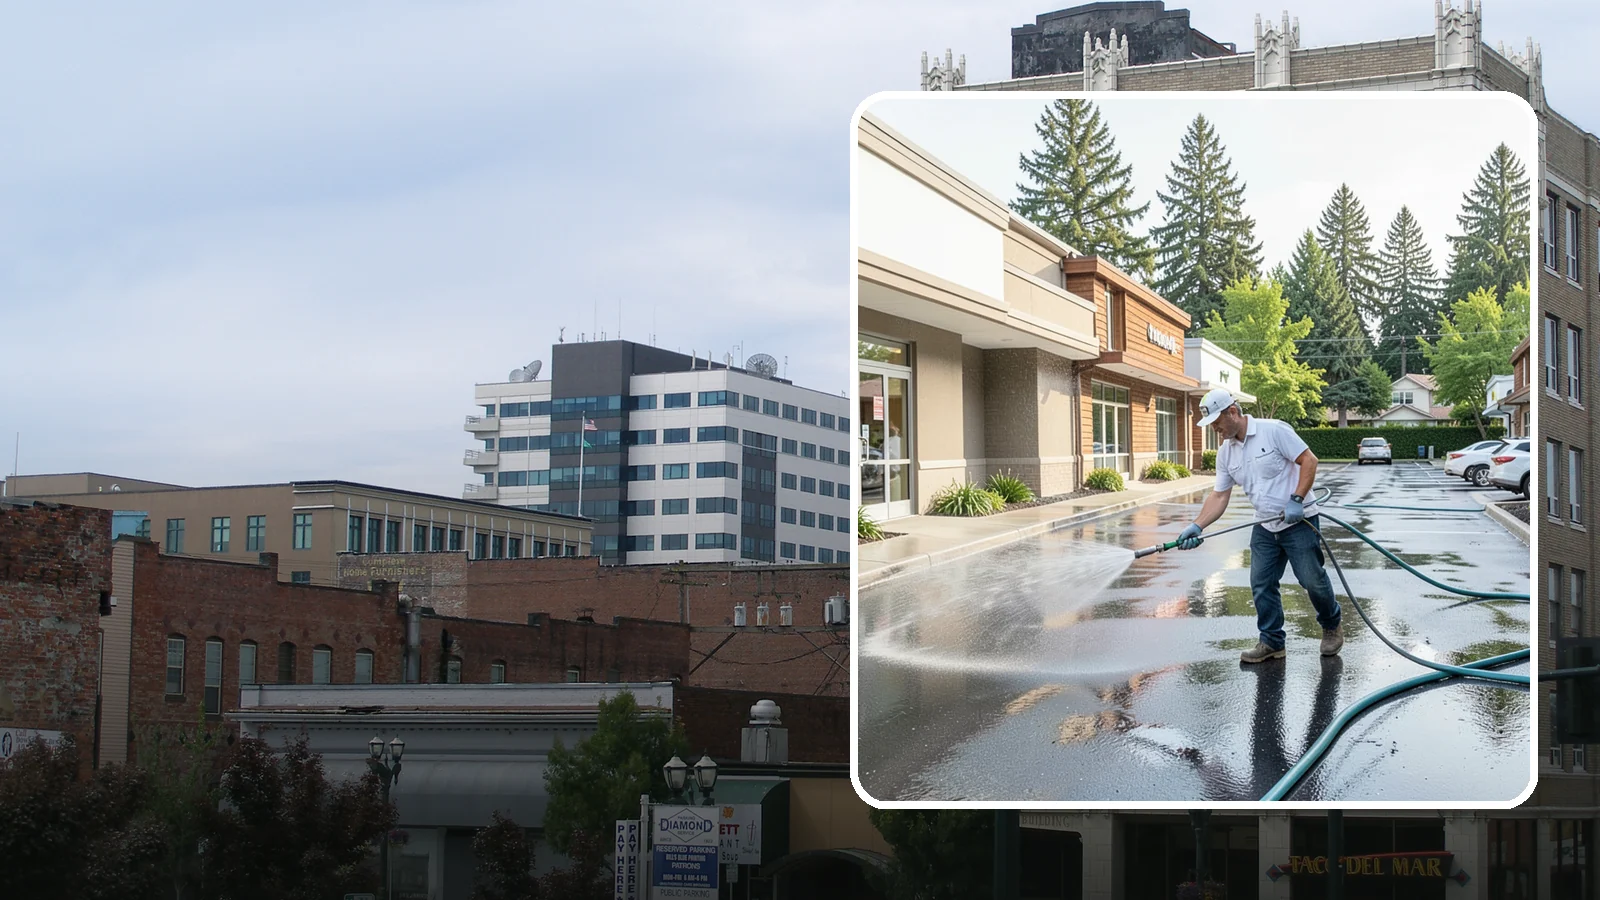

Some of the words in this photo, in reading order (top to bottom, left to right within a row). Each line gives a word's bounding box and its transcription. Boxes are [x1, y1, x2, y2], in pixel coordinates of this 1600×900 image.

[343, 567, 368, 577] Home
[370, 565, 427, 577] Furnishers
[660, 818, 713, 832] DIAMOND
[1021, 815, 1070, 827] BUILDING
[719, 824, 740, 835] ETT
[617, 824, 625, 852] PAY
[628, 824, 637, 852] PAY
[656, 845, 688, 853] RESERVED
[721, 851, 739, 861] Soup
[1289, 855, 1331, 875] TAC
[1345, 856, 1385, 876] DEL
[1392, 857, 1443, 877] MAR
[616, 856, 625, 893] HERE
[627, 856, 636, 893] HERE
[660, 889, 682, 897] PUBLIC
[683, 889, 710, 898] PARKING
